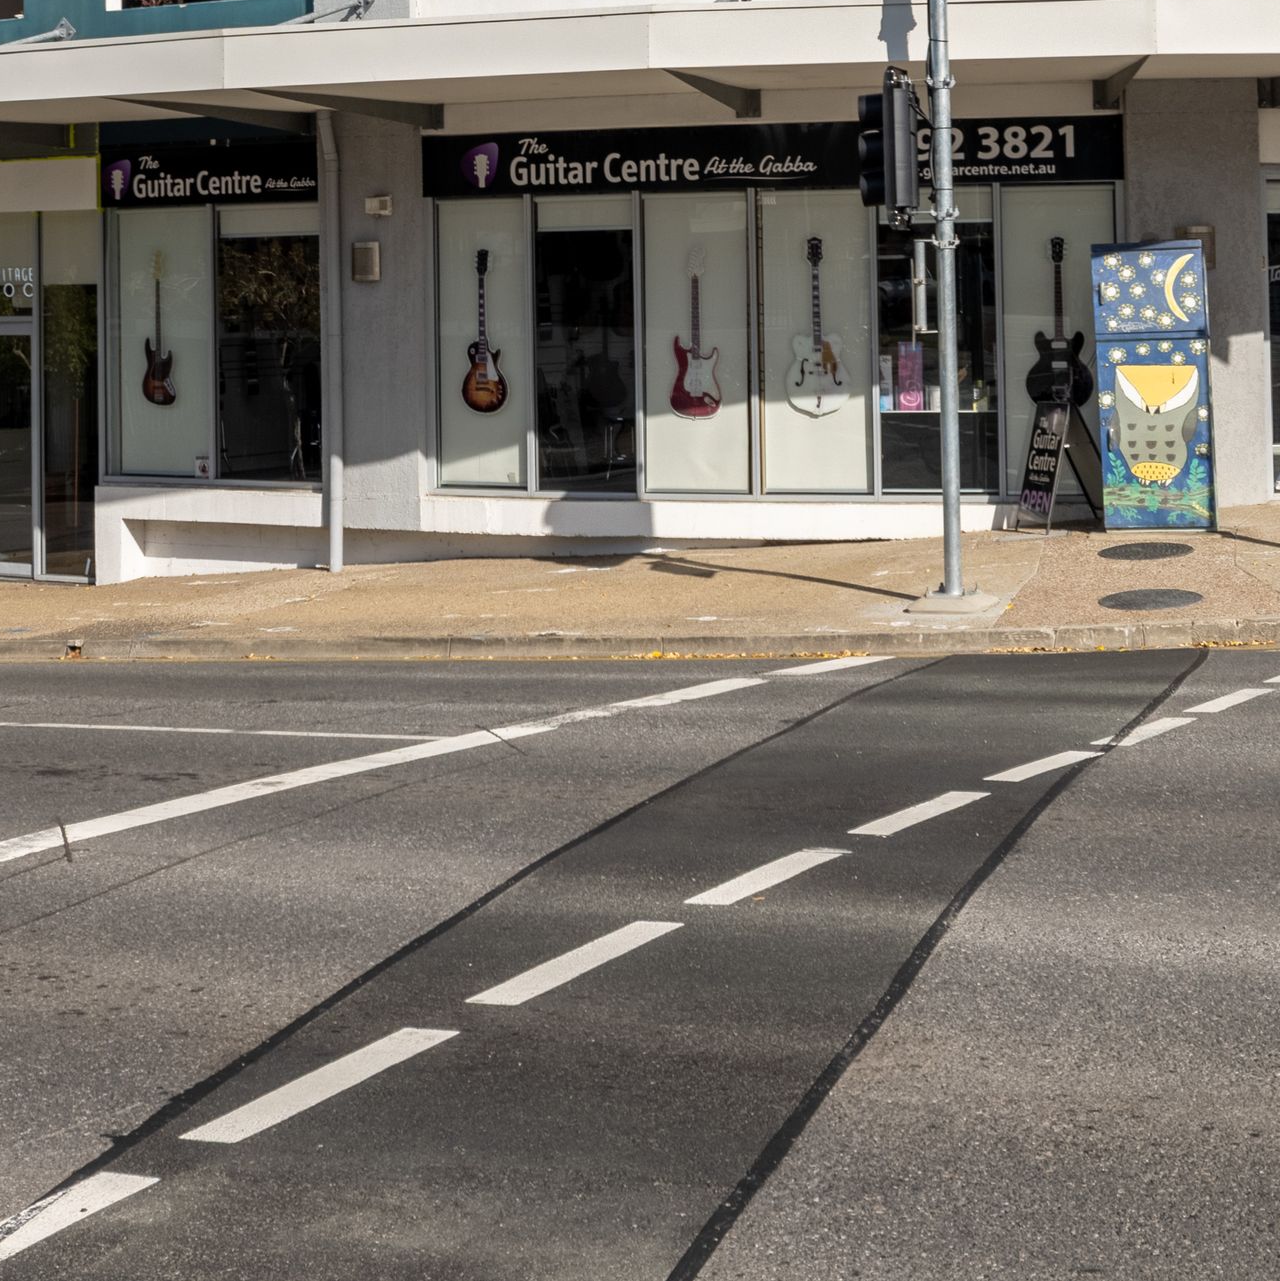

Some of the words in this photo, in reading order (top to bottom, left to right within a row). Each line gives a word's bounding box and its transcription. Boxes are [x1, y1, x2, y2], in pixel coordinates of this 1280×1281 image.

[518, 137, 549, 155] The
[976, 124, 1075, 161] 3821
[138, 155, 160, 170] The
[509, 153, 598, 185] Guitar
[603, 152, 700, 183] Centre
[704, 156, 727, 175] At
[726, 156, 754, 174] the
[759, 154, 817, 175] Gabba
[132, 172, 195, 199] Guitar
[196, 170, 262, 196] Centre
[290, 176, 316, 189] Gabba
[1033, 429, 1060, 450] Guitar
[1028, 450, 1056, 472] Centre
[1021, 489, 1052, 513] OPEN
